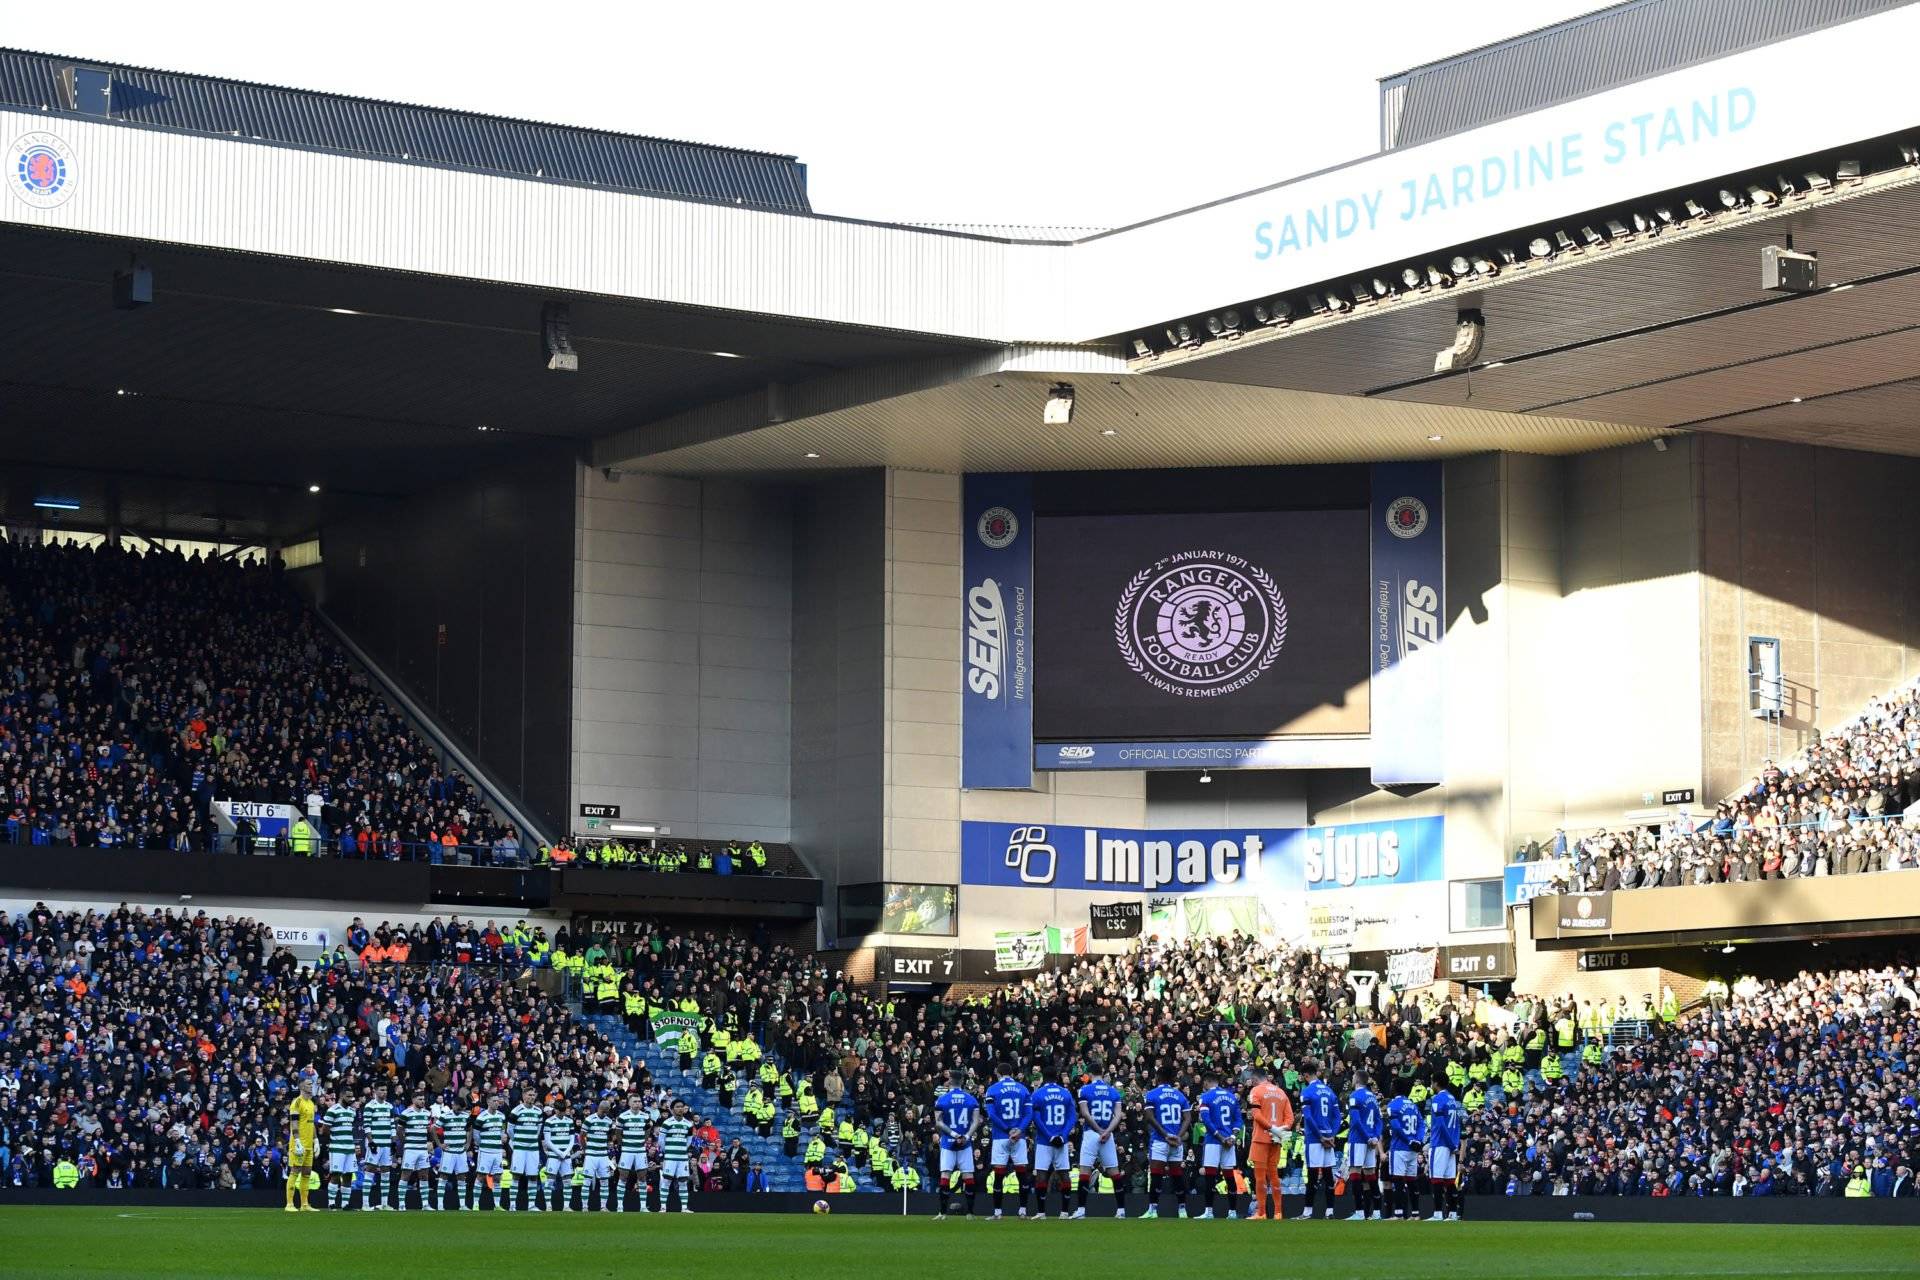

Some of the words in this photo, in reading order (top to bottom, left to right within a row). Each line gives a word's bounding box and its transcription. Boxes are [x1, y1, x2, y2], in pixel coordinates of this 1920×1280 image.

[1253, 189, 1385, 261] SANDY
[1400, 133, 1585, 222] JARDINE
[1604, 86, 1758, 165] STAND
[1172, 550, 1224, 564] JANUARY
[1226, 553, 1248, 568] 1971
[1149, 569, 1254, 603] RANGERS
[1014, 587, 1025, 637] Delivered
[1377, 580, 1391, 640] Intelligence
[968, 577, 1003, 700] SEKO
[1143, 634, 1225, 678] FOOTBALL
[1225, 632, 1260, 669] CLUB
[1184, 651, 1219, 661] READY
[1014, 640, 1027, 700] Intelligence
[1141, 670, 1183, 696] ALWAYS
[1185, 668, 1261, 698] REMEMBERED
[1059, 746, 1096, 759] SEKO
[1119, 749, 1169, 760] OFFICIAL
[1173, 748, 1231, 760] LOGISTICS
[1665, 793, 1682, 802] EXIT
[1685, 792, 1690, 801] 8
[231, 803, 263, 816] EXIT
[266, 805, 274, 817] 6
[584, 807, 606, 816] EXIT
[609, 807, 615, 816] 7
[1084, 829, 1263, 890] Impact
[1305, 828, 1400, 887] signs
[1093, 904, 1140, 918] NEILSTON
[633, 921, 642, 935] 7
[1106, 919, 1127, 930] CSC
[1561, 918, 1571, 927] NO
[276, 930, 300, 941] EXIT
[302, 931, 308, 941] 6
[894, 959, 933, 975] EXIT
[943, 960, 954, 976] 7
[1451, 956, 1480, 973] EXIT
[1486, 955, 1496, 971] 8
[1588, 953, 1617, 967] EXIT
[1621, 952, 1629, 965] 8
[1001, 1098, 1020, 1120] 31
[1046, 1104, 1065, 1125] 18
[1091, 1100, 1113, 1121] 26
[1160, 1103, 1182, 1125] 20
[1220, 1105, 1231, 1126] 2
[1271, 1102, 1277, 1122] 1
[1320, 1096, 1328, 1117] 6
[948, 1107, 969, 1128] 14
[1366, 1109, 1374, 1129] 4
[1402, 1114, 1417, 1135] 30
[1447, 1109, 1457, 1129] 71
